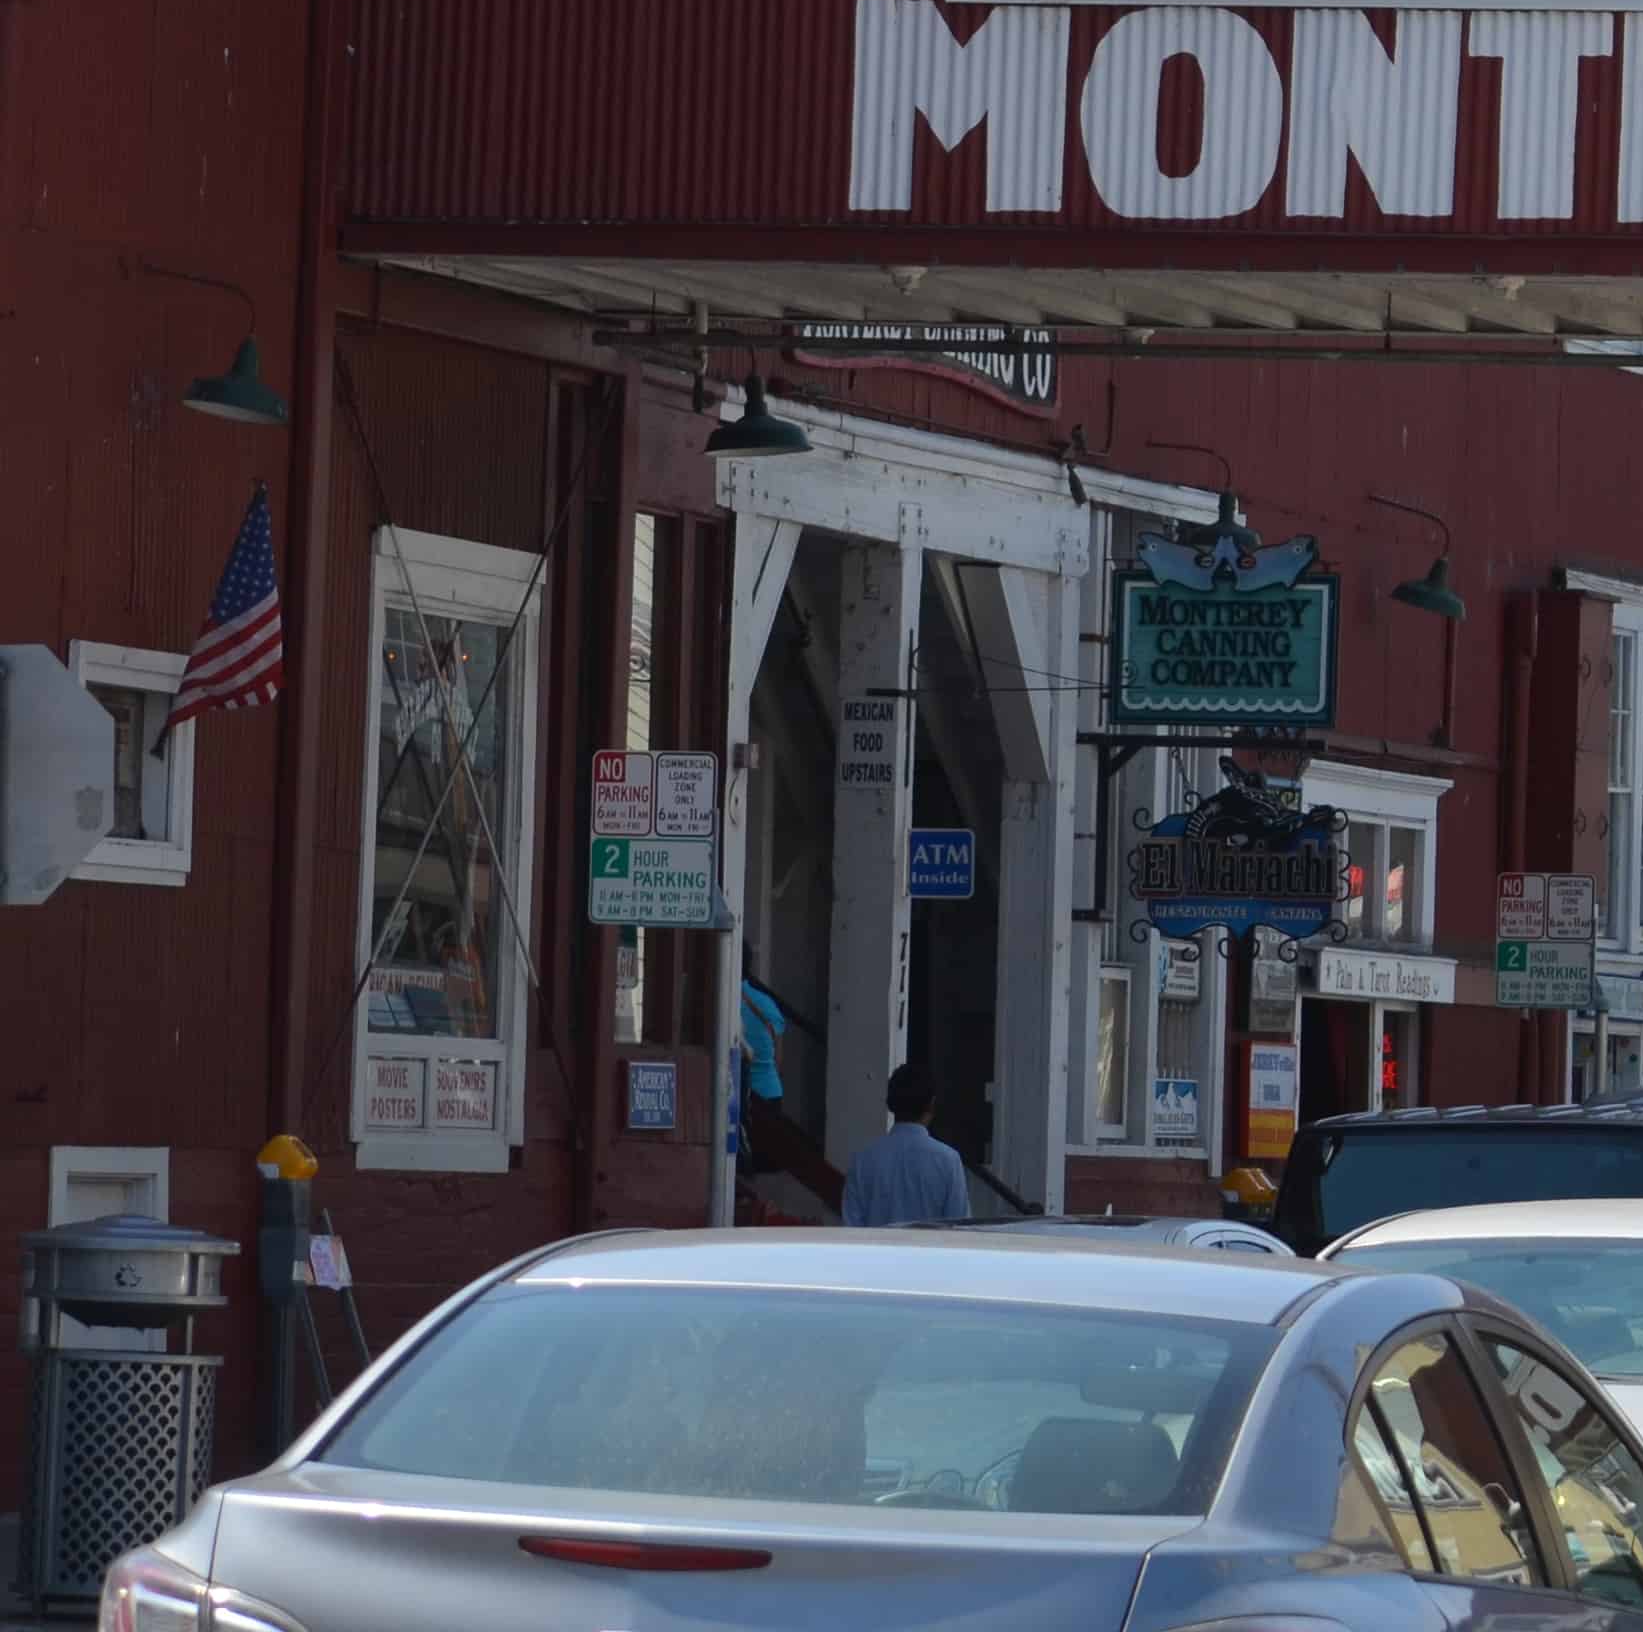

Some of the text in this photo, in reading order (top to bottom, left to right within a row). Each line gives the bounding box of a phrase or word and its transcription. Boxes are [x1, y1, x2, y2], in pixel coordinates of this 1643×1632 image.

[1139, 594, 1312, 629] MONTEREY
[1157, 629, 1292, 657] CANNING
[1150, 658, 1297, 689] COMPANY
[844, 701, 894, 722] MEXICAN
[853, 733, 883, 752] FOOD
[599, 757, 623, 780] NO
[841, 762, 893, 783] UPSTAIRS
[597, 785, 649, 802] PARKING
[604, 844, 621, 873] 2
[632, 849, 670, 868] HOUR
[912, 843, 970, 865] ATM
[632, 870, 707, 889] PARKING
[911, 871, 970, 885] Inside
[1503, 879, 1522, 898] NO
[1507, 946, 1520, 968] 2
[1529, 966, 1588, 980] PARKING
[376, 1063, 408, 1089] MOVIE
[370, 1097, 417, 1121] POSTERS
